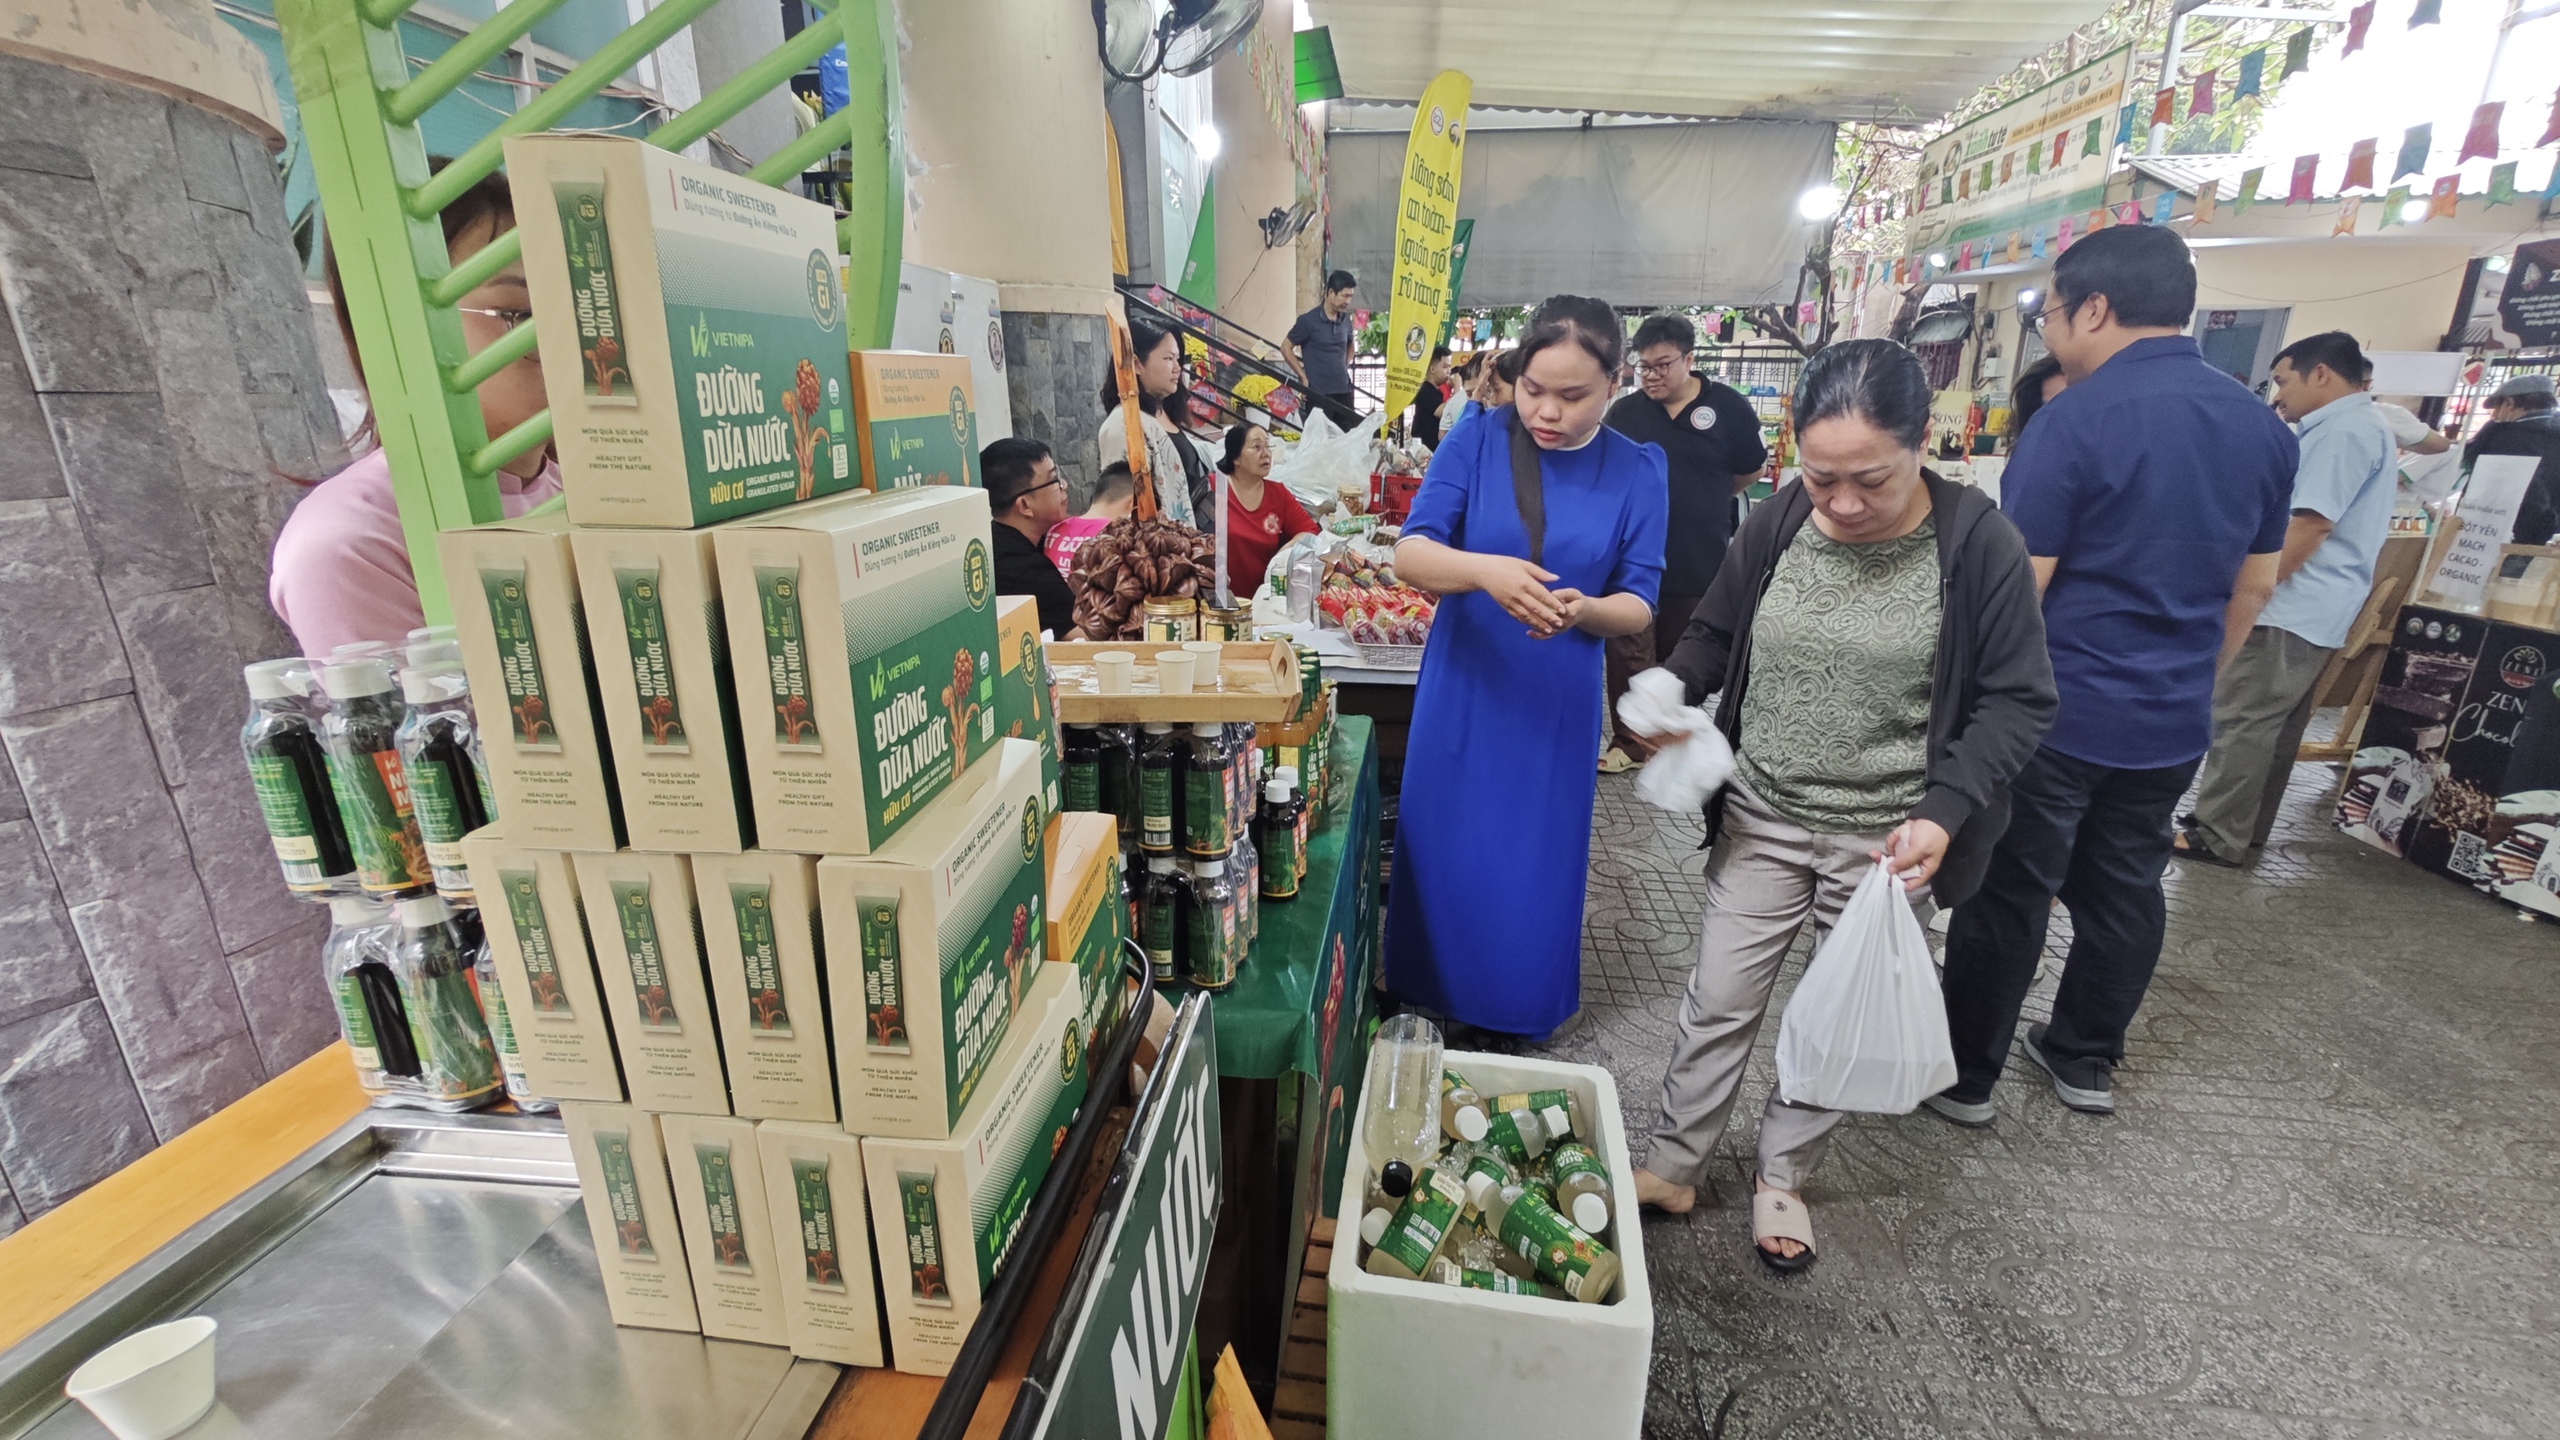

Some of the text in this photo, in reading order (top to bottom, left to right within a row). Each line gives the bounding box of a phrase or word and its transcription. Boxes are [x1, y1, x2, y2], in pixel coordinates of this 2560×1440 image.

[680, 174, 777, 218] ORGANIC SWEETENER
[1430, 246, 1448, 277] gố
[576, 289, 597, 336] ĐƯỜNG
[588, 270, 615, 336] DỪA NƯỚC
[713, 332, 755, 347] VIETNIPA
[695, 364, 764, 418] ĐƯỜNG
[880, 368, 940, 380] ORGANIC SWEETENER
[702, 420, 748, 474] DỪA
[745, 415, 791, 468] NƯỚC
[708, 479, 745, 506] HỮU CƠ
[861, 520, 940, 557] ORGANIC SWEETENER
[2439, 567, 2482, 585] ORGANIC
[2448, 552, 2479, 567] CACAO
[972, 567, 983, 594] GI
[503, 656, 524, 695] ĐƯỜNG
[514, 641, 539, 695] DỪA NƯỚC
[635, 656, 654, 695] ĐƯỜNG
[646, 641, 669, 695] DỪA NƯỚC
[771, 655, 788, 694] ĐƯỜNG
[782, 639, 804, 695] DỪA NƯỚC
[887, 654, 920, 682] VIETNIPA
[873, 684, 927, 754] ĐƯỜNG
[2486, 691, 2528, 714] ZEN
[2449, 703, 2523, 747] Chocol
[878, 714, 948, 801] DỪA NƯỚC
[883, 788, 911, 826] HỮU CƠ
[951, 800, 1005, 875] ORGANIC SWEETENER
[1027, 819, 1035, 848] GI
[966, 933, 989, 973] VIETNIPA
[866, 971, 881, 1004] ĐƯỜNG
[878, 958, 896, 1005] DỪA NƯỚC
[955, 957, 992, 1045] ĐƯỜNG
[958, 974, 1007, 1085] DỪA NƯỚC
[1110, 1064, 1217, 1440] NƯỚC
